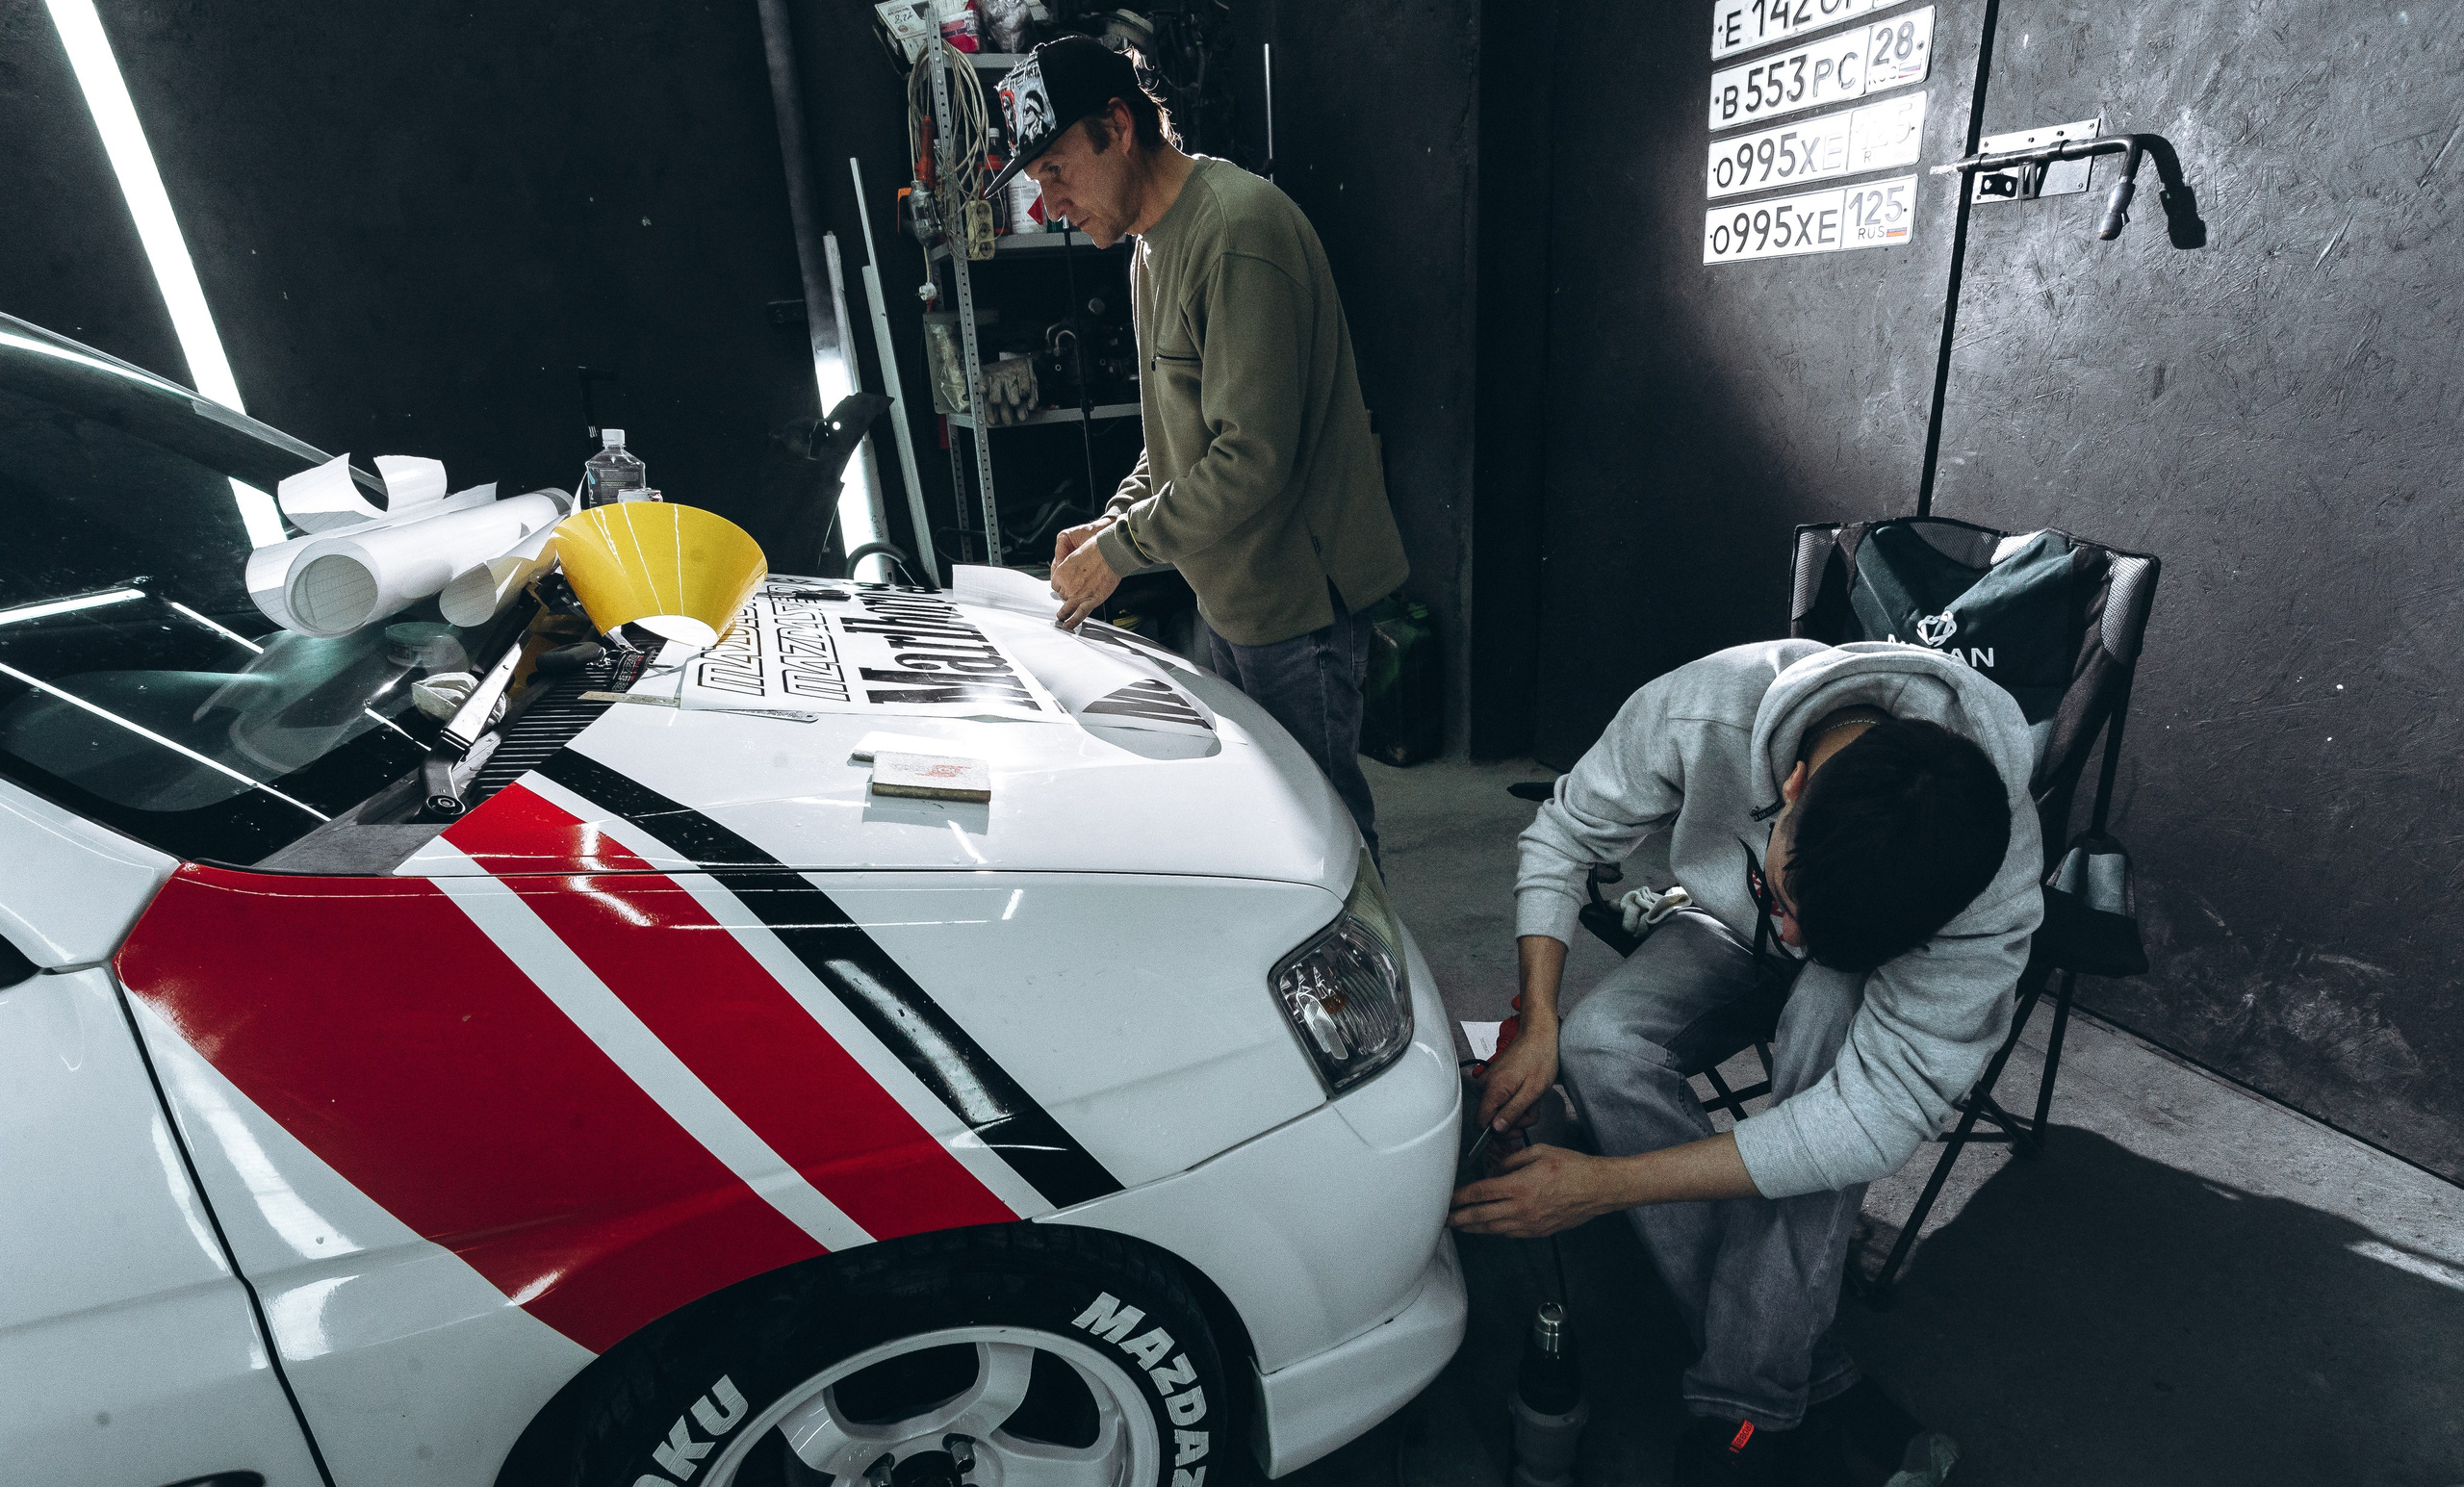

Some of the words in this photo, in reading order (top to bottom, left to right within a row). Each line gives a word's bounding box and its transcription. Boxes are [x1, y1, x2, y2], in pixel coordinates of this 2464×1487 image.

[1872, 20, 1915, 67] 28
[1848, 185, 1905, 227] 125
[1858, 226, 1886, 240] RUS
[839, 592, 1042, 711] Marlboro
[630, 1373, 749, 1487] KU
